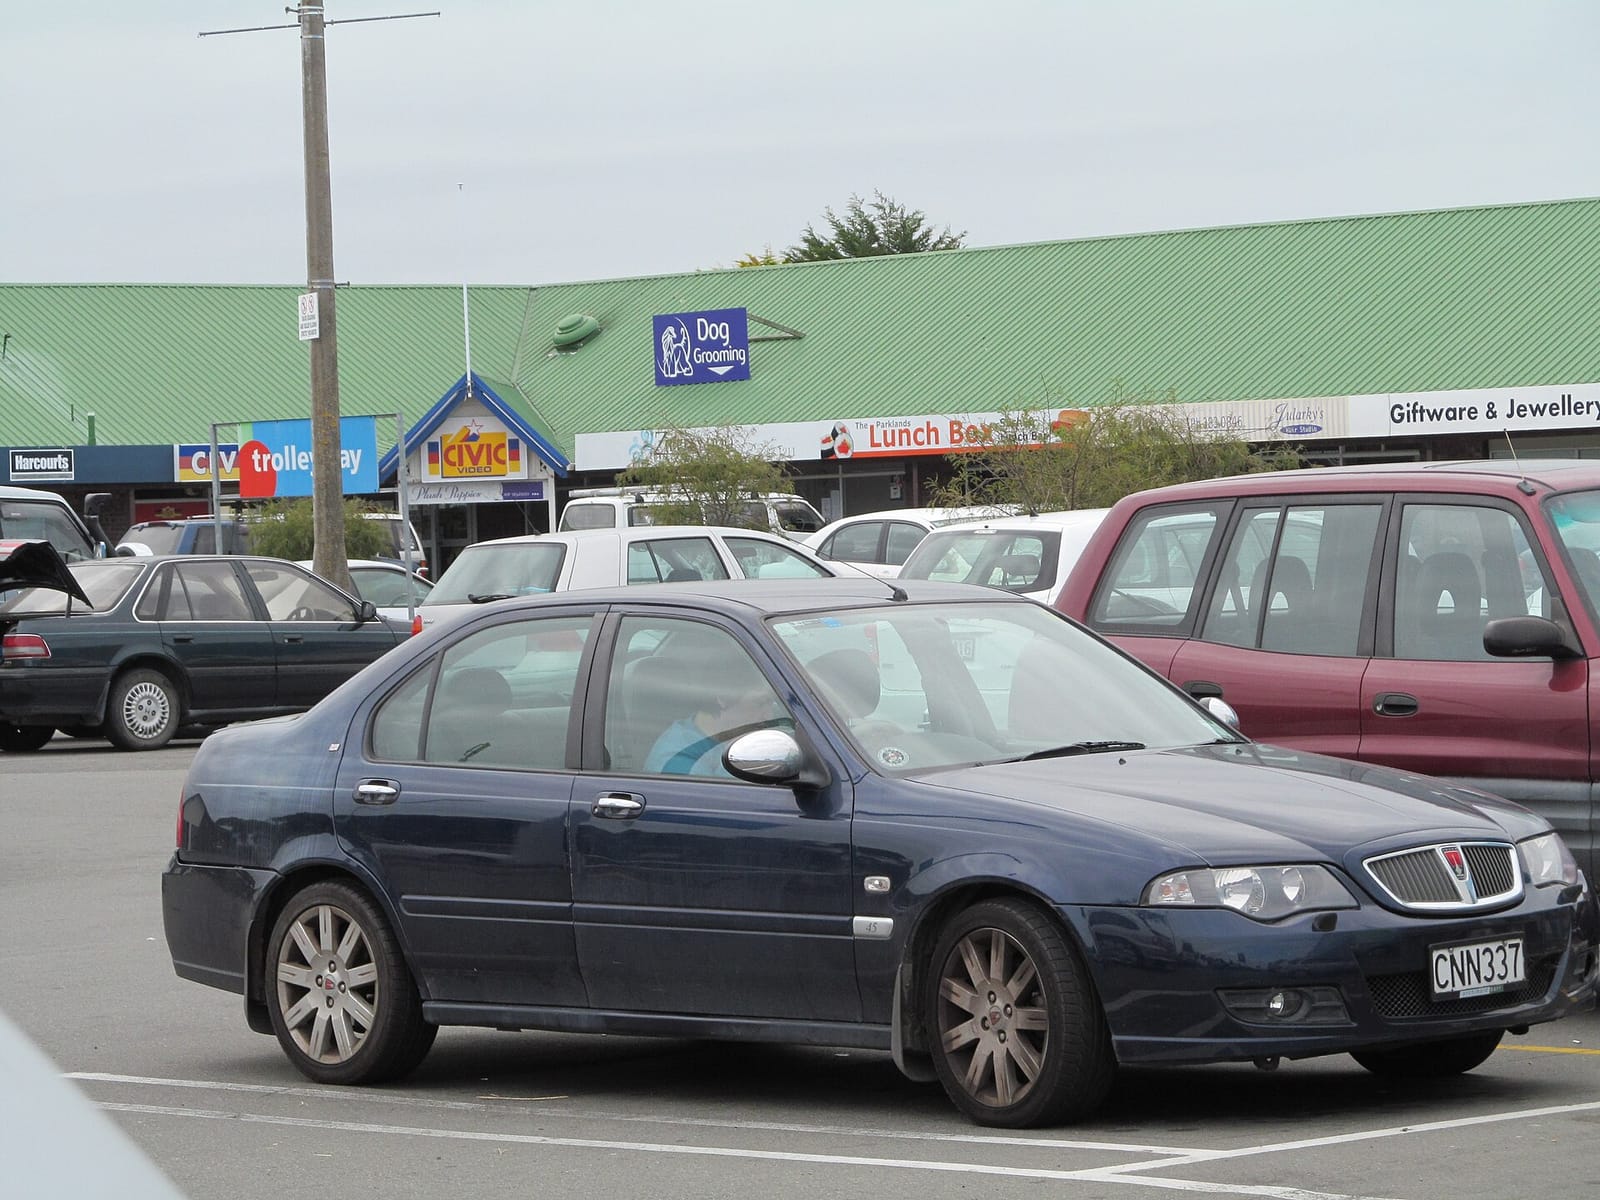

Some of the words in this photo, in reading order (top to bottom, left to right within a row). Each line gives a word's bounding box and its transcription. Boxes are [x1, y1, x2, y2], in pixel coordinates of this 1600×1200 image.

[697, 318, 730, 346] Dog
[693, 345, 746, 365] Grooming
[1390, 402, 1479, 424] Giftware
[1485, 401, 1498, 420] &
[855, 422, 868, 430] The
[876, 420, 911, 429] Parklands
[869, 421, 940, 448] Lunch
[14, 454, 69, 471] Harcourts
[191, 450, 237, 475] CIV
[443, 444, 506, 466] CIVIC
[457, 466, 491, 474] VIDEO
[1435, 943, 1520, 989] CNN337
